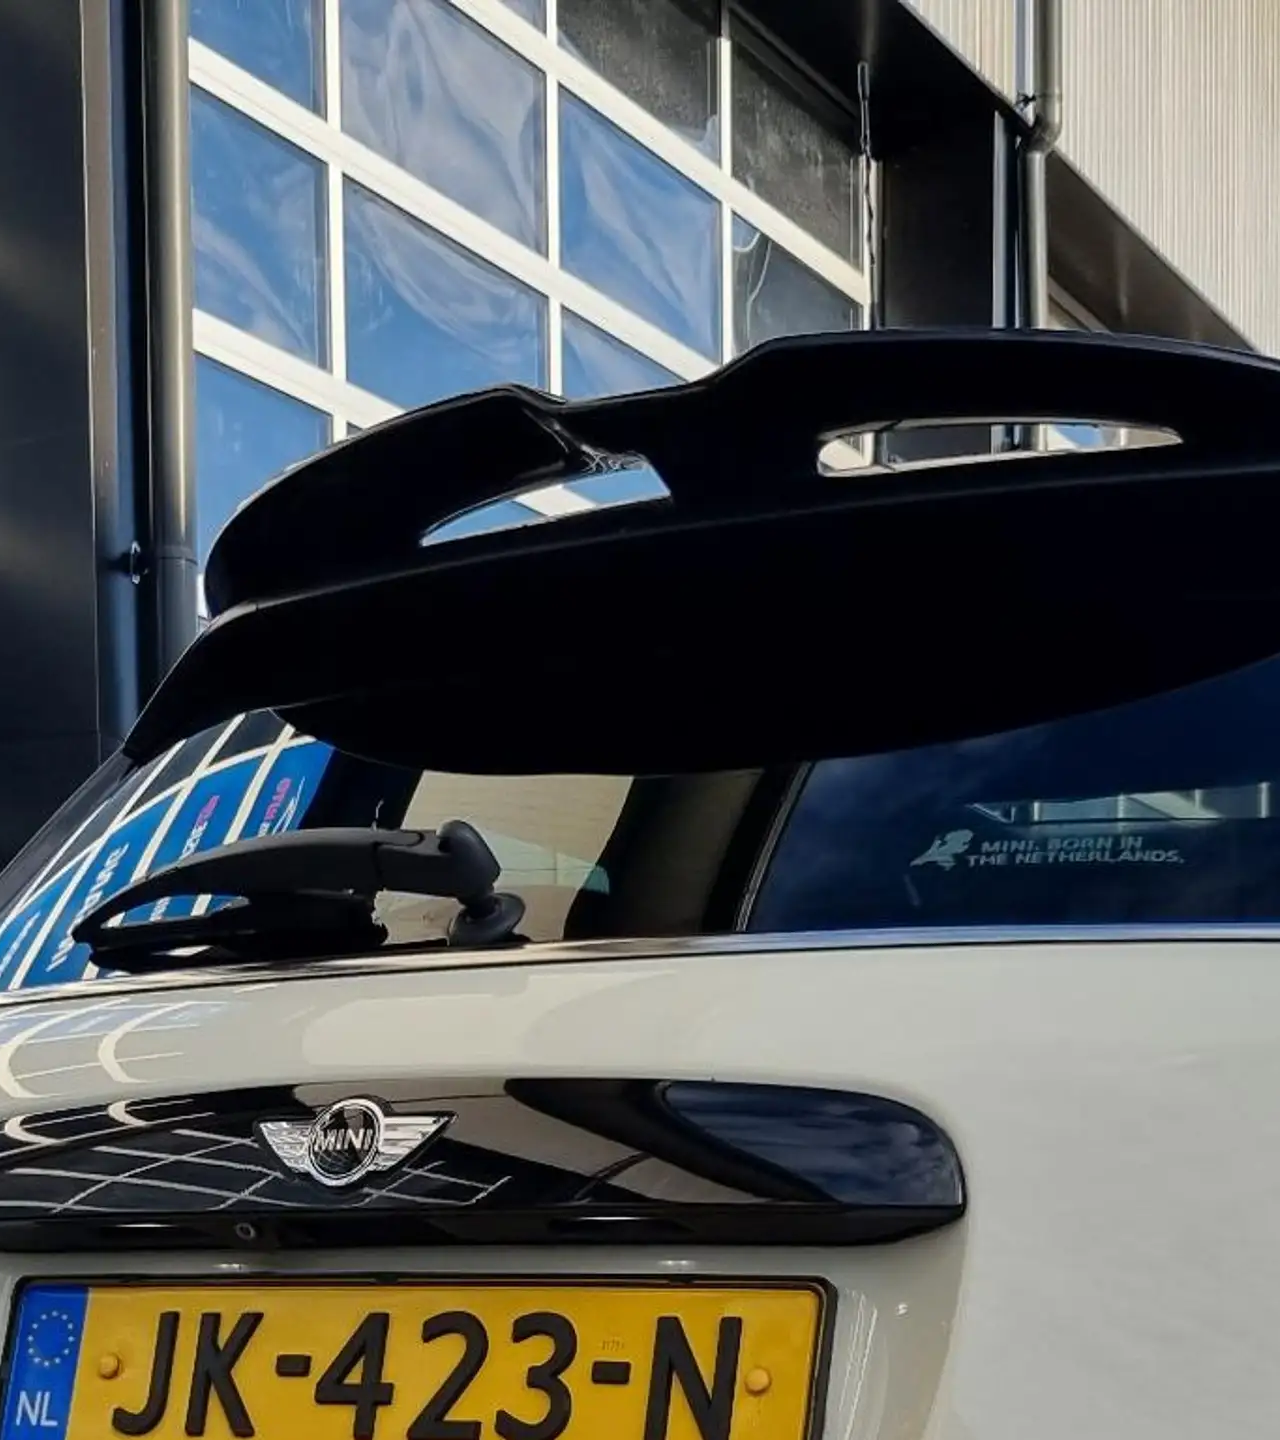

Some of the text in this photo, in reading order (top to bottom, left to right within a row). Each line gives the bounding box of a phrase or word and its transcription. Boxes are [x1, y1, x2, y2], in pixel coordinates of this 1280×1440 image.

[1047, 836, 1113, 850] BORN
[1119, 835, 1144, 850] IN
[967, 853, 1009, 867] THE
[314, 1128, 375, 1152] MINI
[15, 1391, 58, 1428] NL
